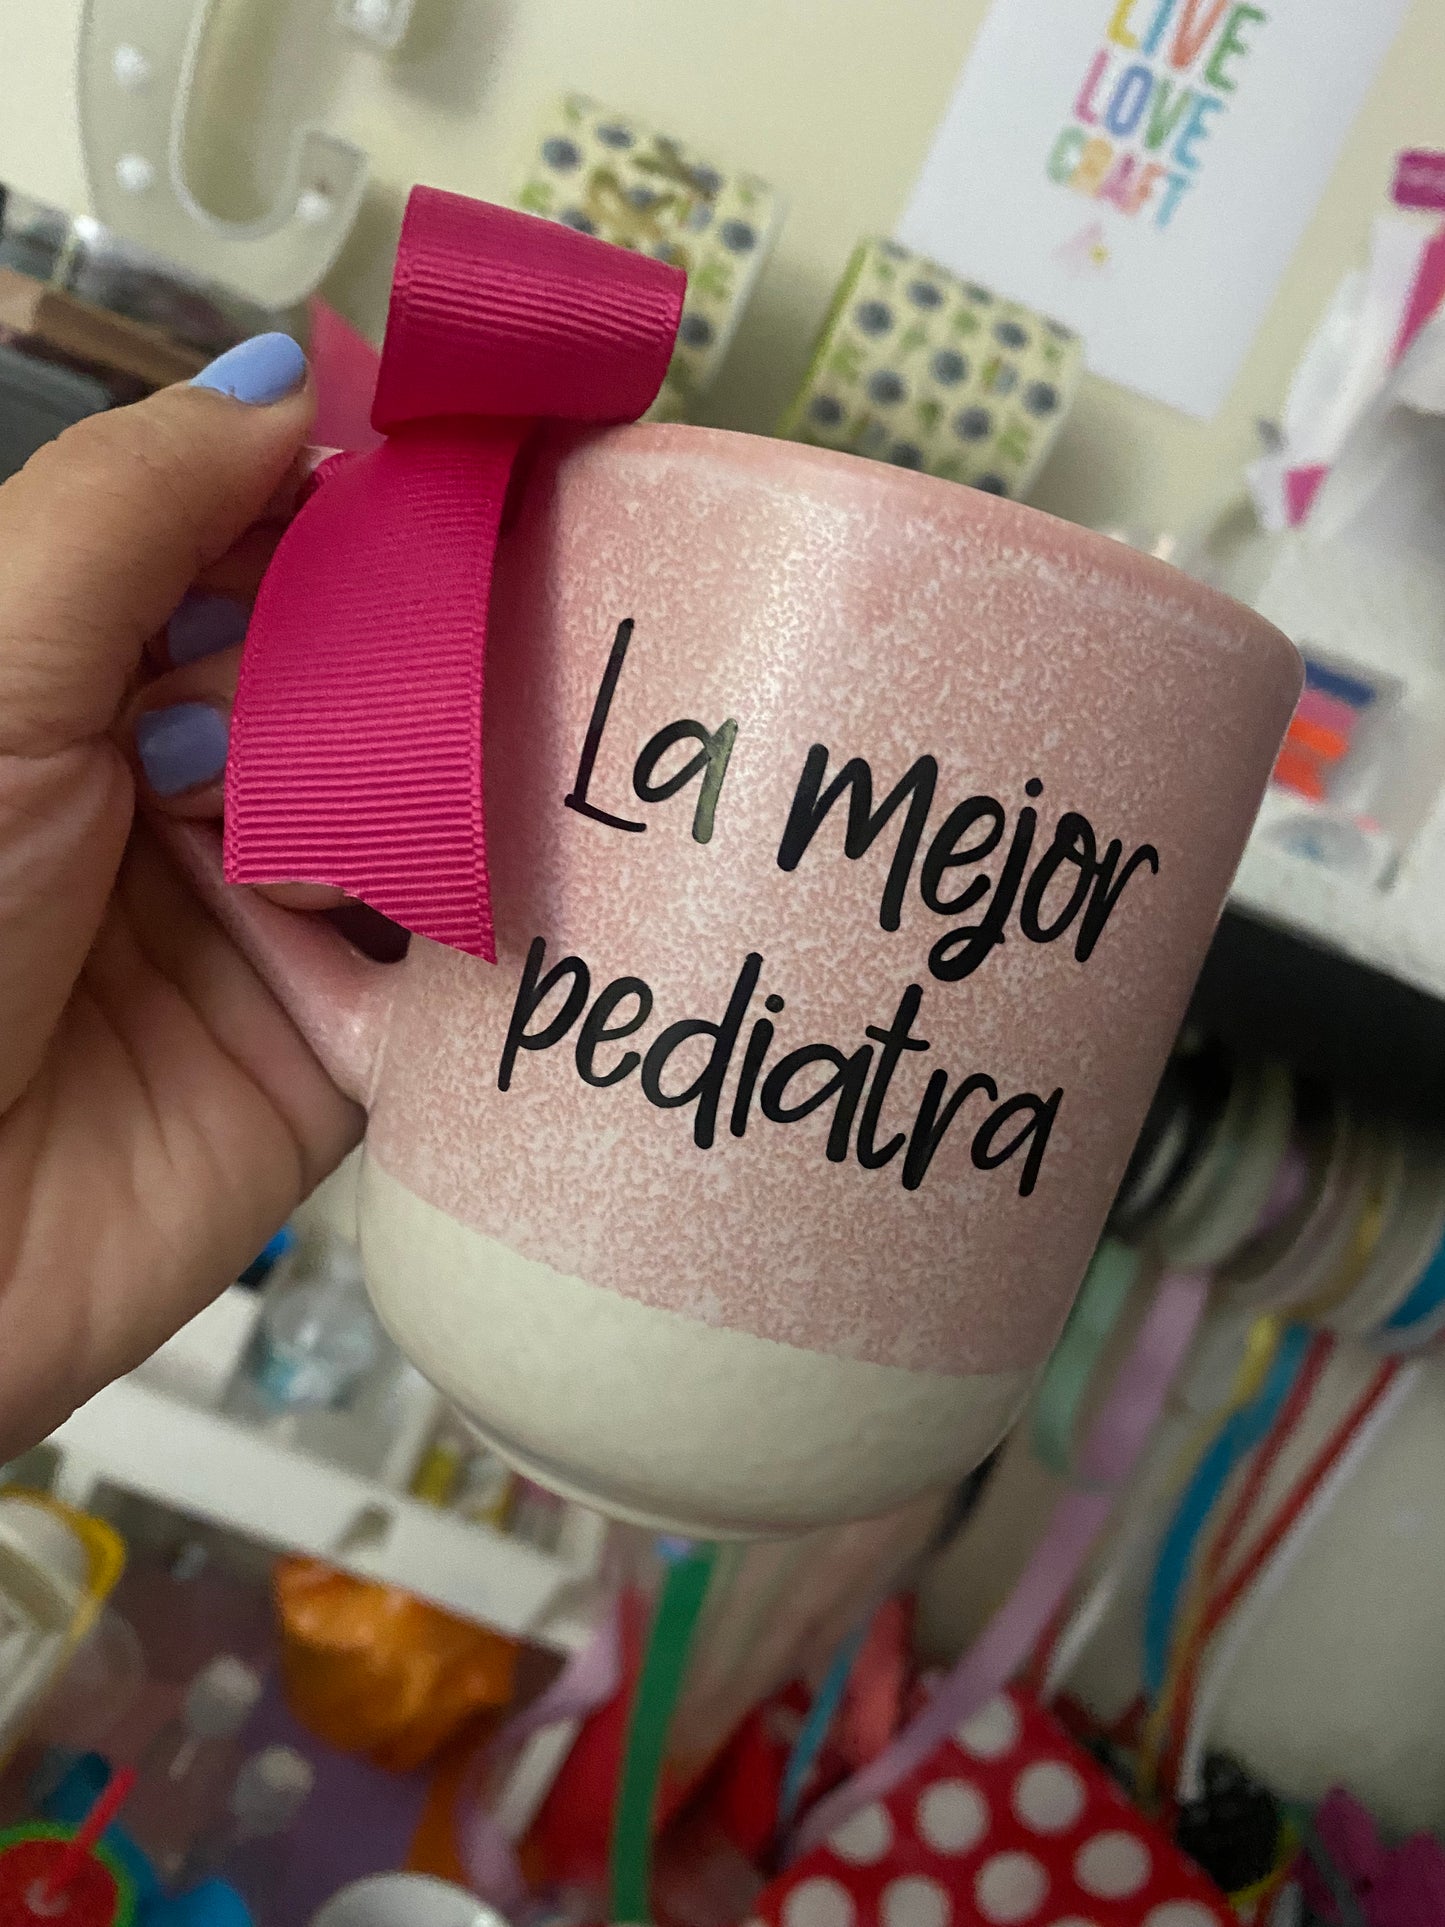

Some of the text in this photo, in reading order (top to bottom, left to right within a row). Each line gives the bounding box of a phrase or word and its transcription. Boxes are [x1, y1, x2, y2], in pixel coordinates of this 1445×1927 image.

[1073, 48, 1225, 172] LOVE
[564, 617, 738, 844] La
[497, 936, 1064, 1198] pediatra
